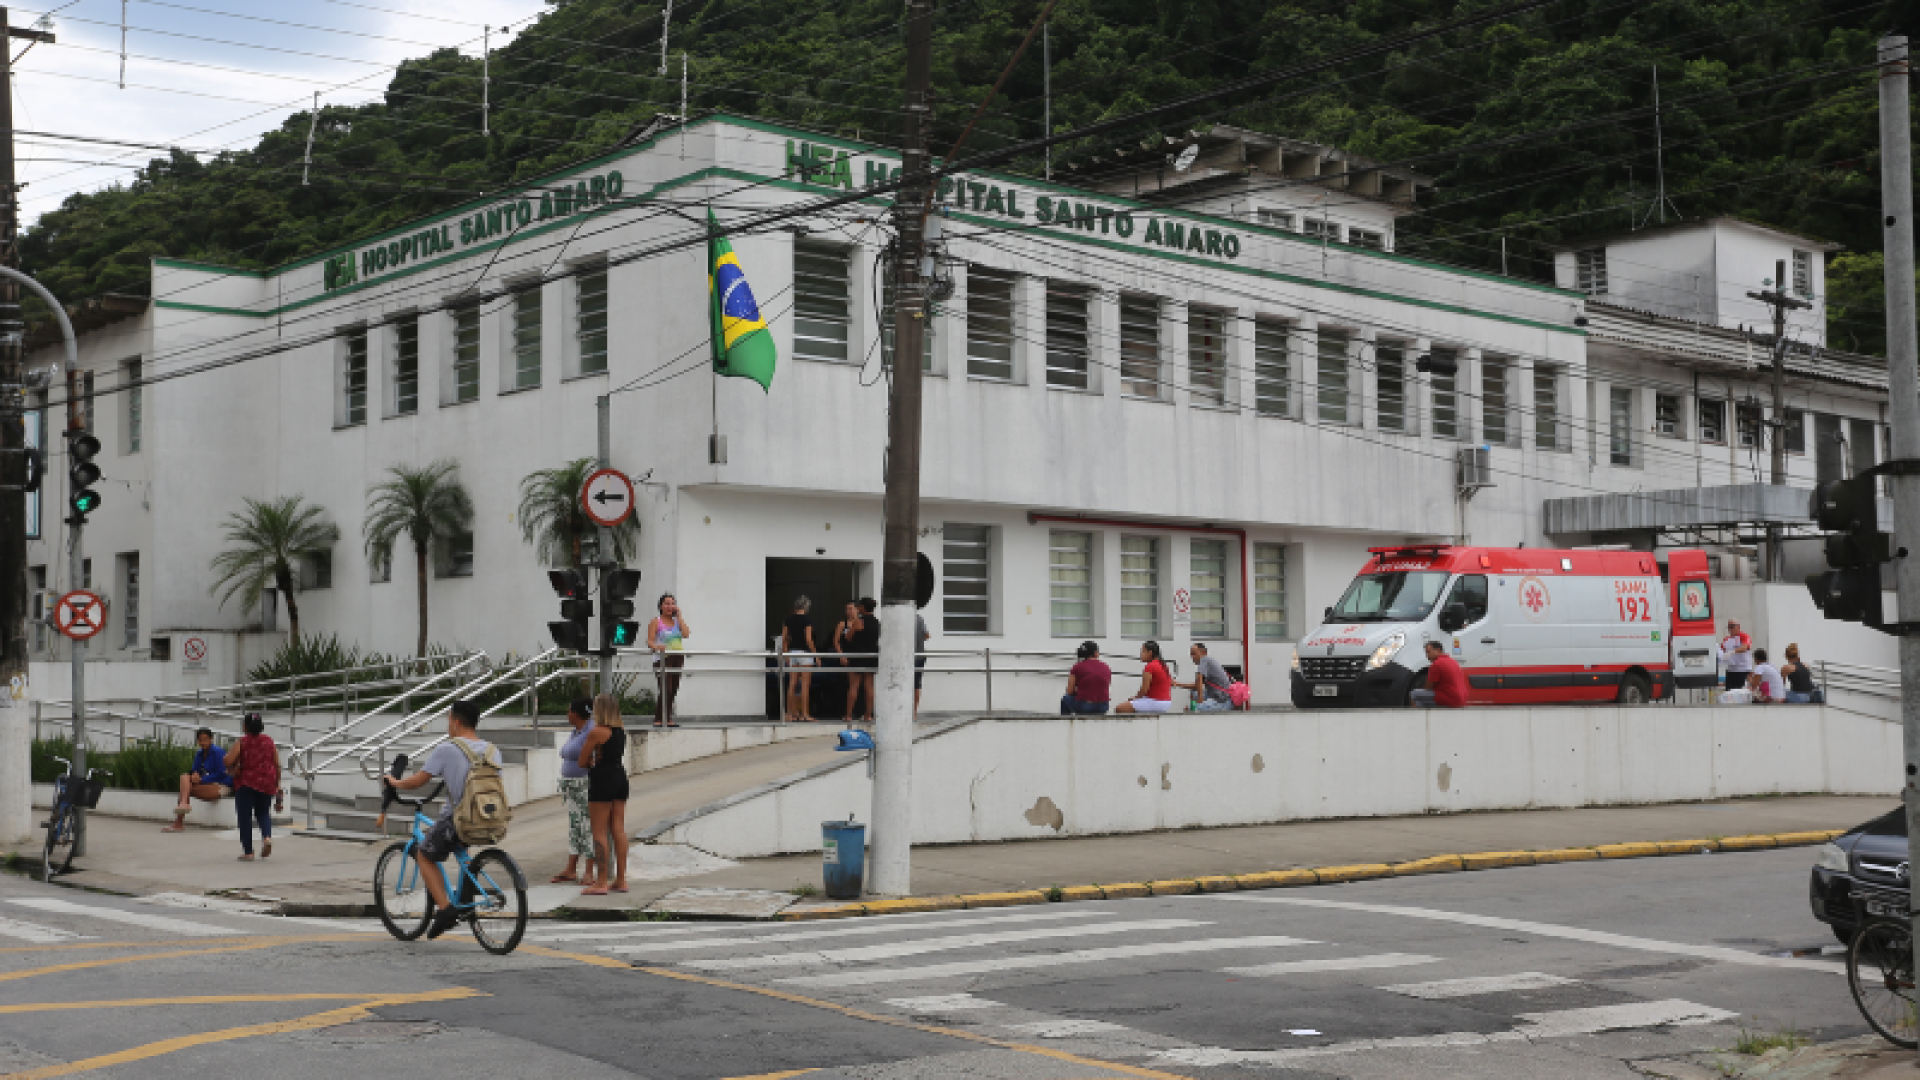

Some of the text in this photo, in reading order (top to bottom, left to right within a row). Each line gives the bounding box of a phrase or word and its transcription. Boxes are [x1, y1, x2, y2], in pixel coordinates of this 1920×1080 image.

[362, 225, 454, 276] HOSPITAL
[460, 199, 532, 245] SANTO
[540, 169, 623, 219] AMARO
[865, 160, 1026, 218] HPITAL
[1035, 196, 1134, 238] SANTO
[1144, 218, 1240, 259] AMARO
[1614, 580, 1649, 594] SAMU
[1615, 597, 1651, 622] 192
